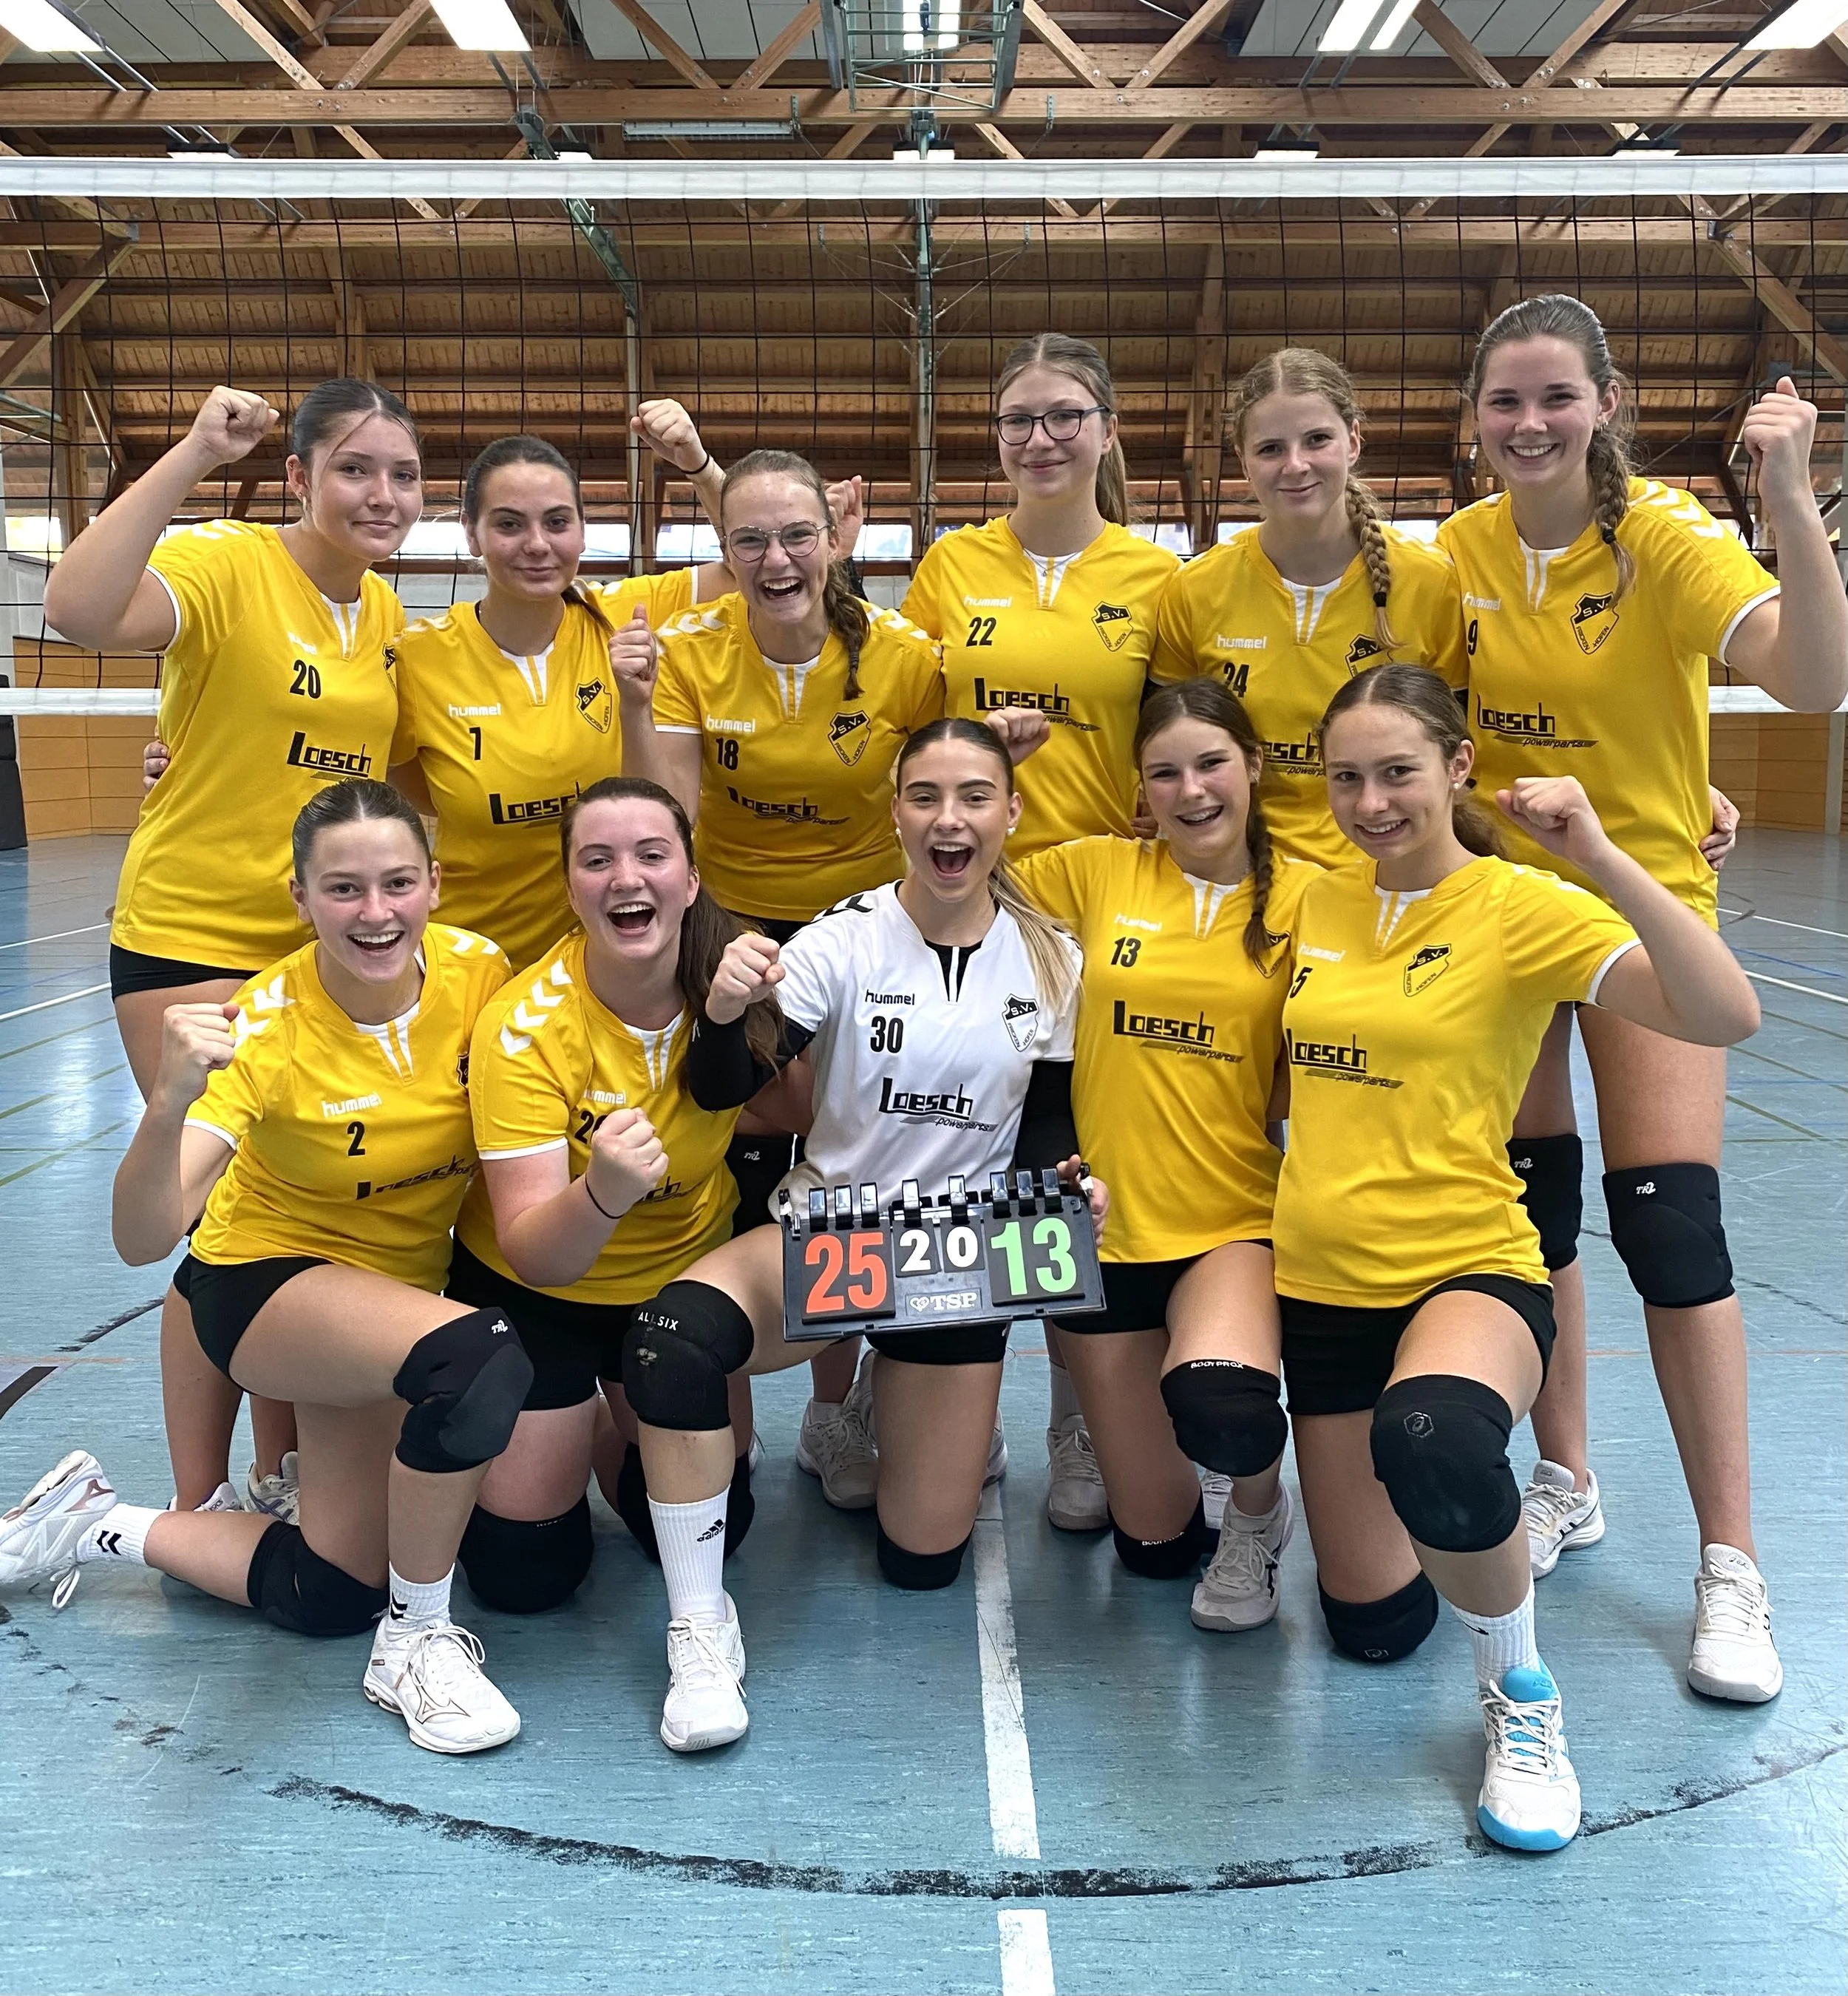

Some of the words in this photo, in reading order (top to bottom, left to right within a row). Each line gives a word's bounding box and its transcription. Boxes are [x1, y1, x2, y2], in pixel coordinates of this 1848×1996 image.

[964, 595, 1013, 608] hummel
[966, 617, 997, 647] 22
[1217, 634, 1267, 649] hummel
[1467, 619, 1478, 655] 9
[289, 659, 321, 699] 20
[1223, 662, 1249, 698] 24
[448, 702, 501, 717] hummel
[974, 677, 1070, 716] Loesch
[705, 714, 756, 733] hummel
[287, 730, 373, 778] Loesch
[469, 727, 482, 761] 1
[716, 737, 739, 770] 18
[1110, 936, 1142, 968] 13
[864, 988, 916, 1006] hummel
[1289, 966, 1314, 998] 5
[869, 1015, 904, 1053] 30
[1112, 999, 1215, 1048] Loesch
[321, 1091, 382, 1118] hummel
[878, 1076, 974, 1121] Loesch
[347, 1121, 366, 1157] 2
[804, 1231, 888, 1314] 25
[990, 1217, 1078, 1297] 13
[657, 1316, 679, 1331] SIX
